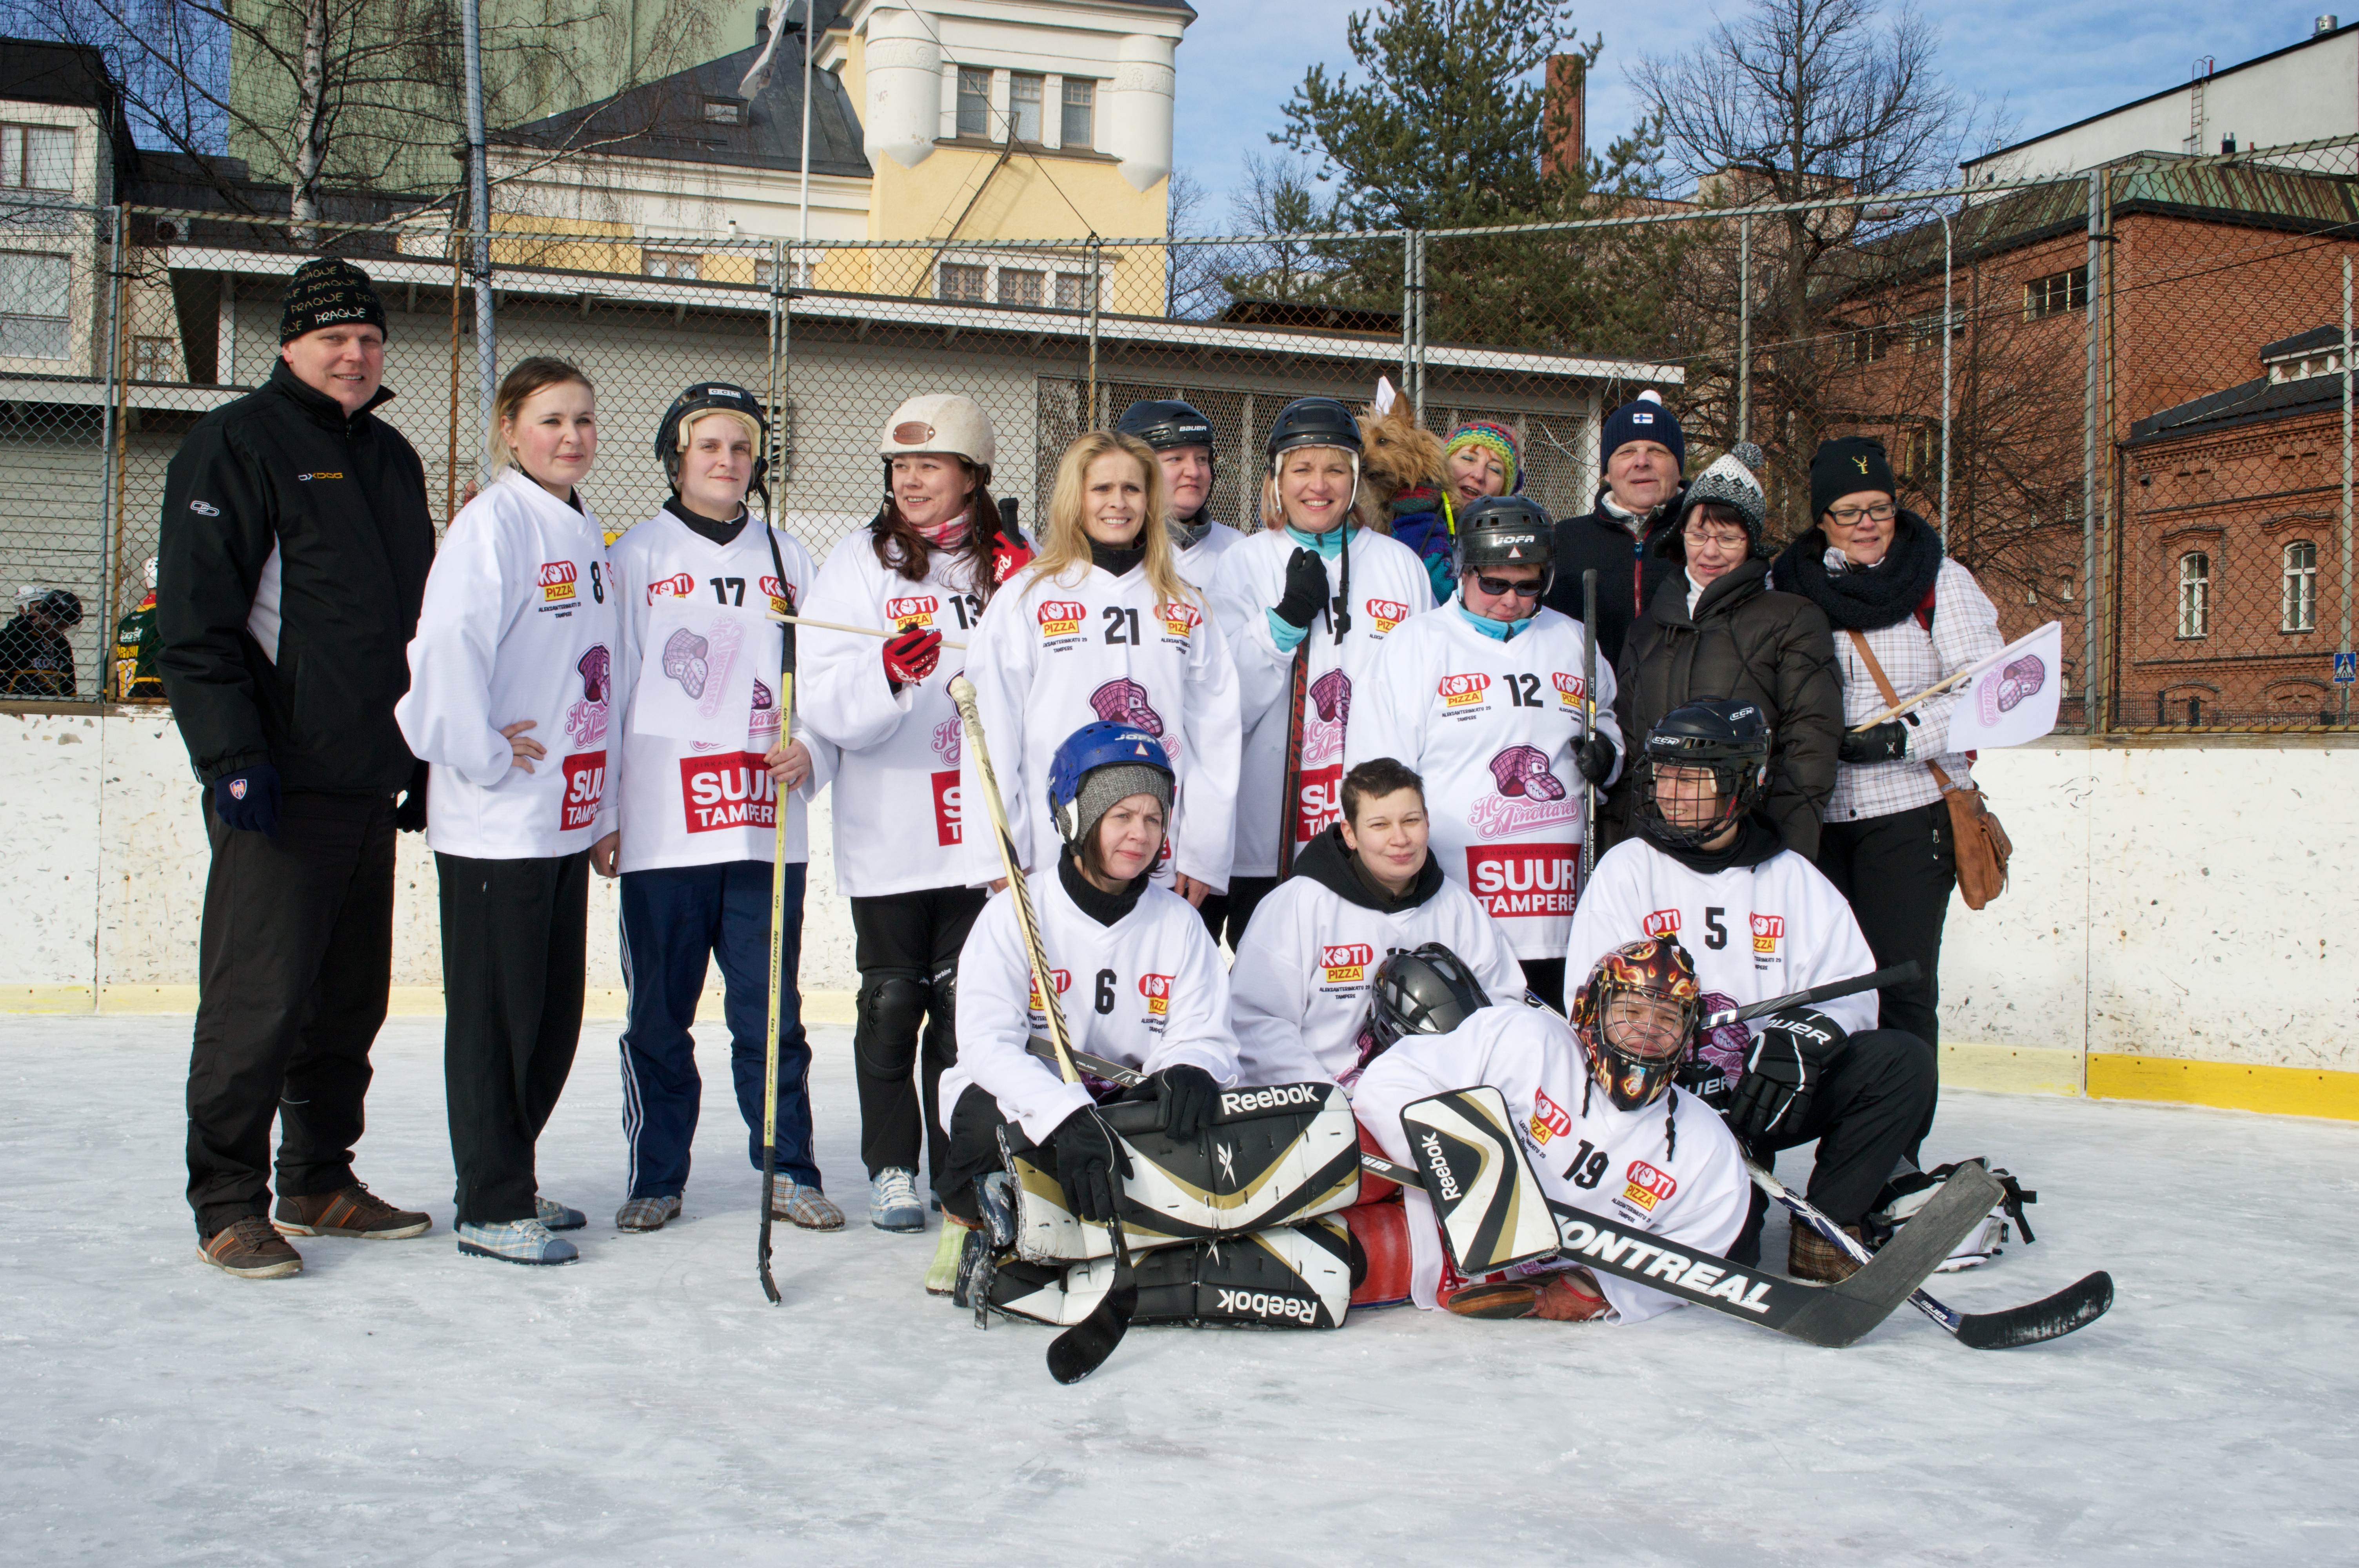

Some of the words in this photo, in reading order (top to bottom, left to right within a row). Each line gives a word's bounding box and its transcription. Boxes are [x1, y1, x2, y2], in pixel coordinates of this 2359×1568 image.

[307, 279, 359, 293] PRAGUE
[291, 292, 344, 314] PRAGUE
[314, 307, 366, 325] PRAGUE
[711, 389, 741, 397] CCM
[298, 472, 343, 481] OXDOG
[1493, 535, 1535, 546] JOFA
[539, 562, 575, 585] KOTI
[590, 561, 604, 604] 8
[546, 584, 573, 598] PIZZA
[709, 577, 746, 607] 17
[889, 597, 934, 617] KOTI
[1041, 603, 1081, 621] KOTI
[1044, 622, 1076, 634] PIZZA
[1103, 606, 1140, 646] 21
[1443, 674, 1485, 695] KOTI
[1503, 673, 1543, 708] 12
[1448, 692, 1480, 705] PIZZA
[1289, 657, 1308, 773] KARJALA
[1442, 707, 1484, 717] ALEKSANTERINKATU
[1732, 708, 1753, 719] CCM
[1654, 736, 1677, 745] CCM
[1480, 797, 1577, 836] Ainottaret
[1476, 859, 1575, 893] SUUR
[1478, 894, 1576, 913] TAMPERE
[1705, 907, 1727, 950] 5
[1321, 946, 1368, 966] KOTI
[1329, 968, 1360, 980] PIZZA
[1094, 968, 1117, 1015] 6
[1076, 1060, 1097, 1071] FINLAND
[1221, 1082, 1319, 1115] Reebok
[1421, 1131, 1461, 1201] Reebok
[1562, 1139, 1610, 1190] 19
[1628, 1161, 1674, 1200] KOTI
[1627, 1184, 1652, 1210] PIZZA
[1555, 1213, 1772, 1313] ONTREAL
[1217, 1289, 1317, 1324] Reebok
